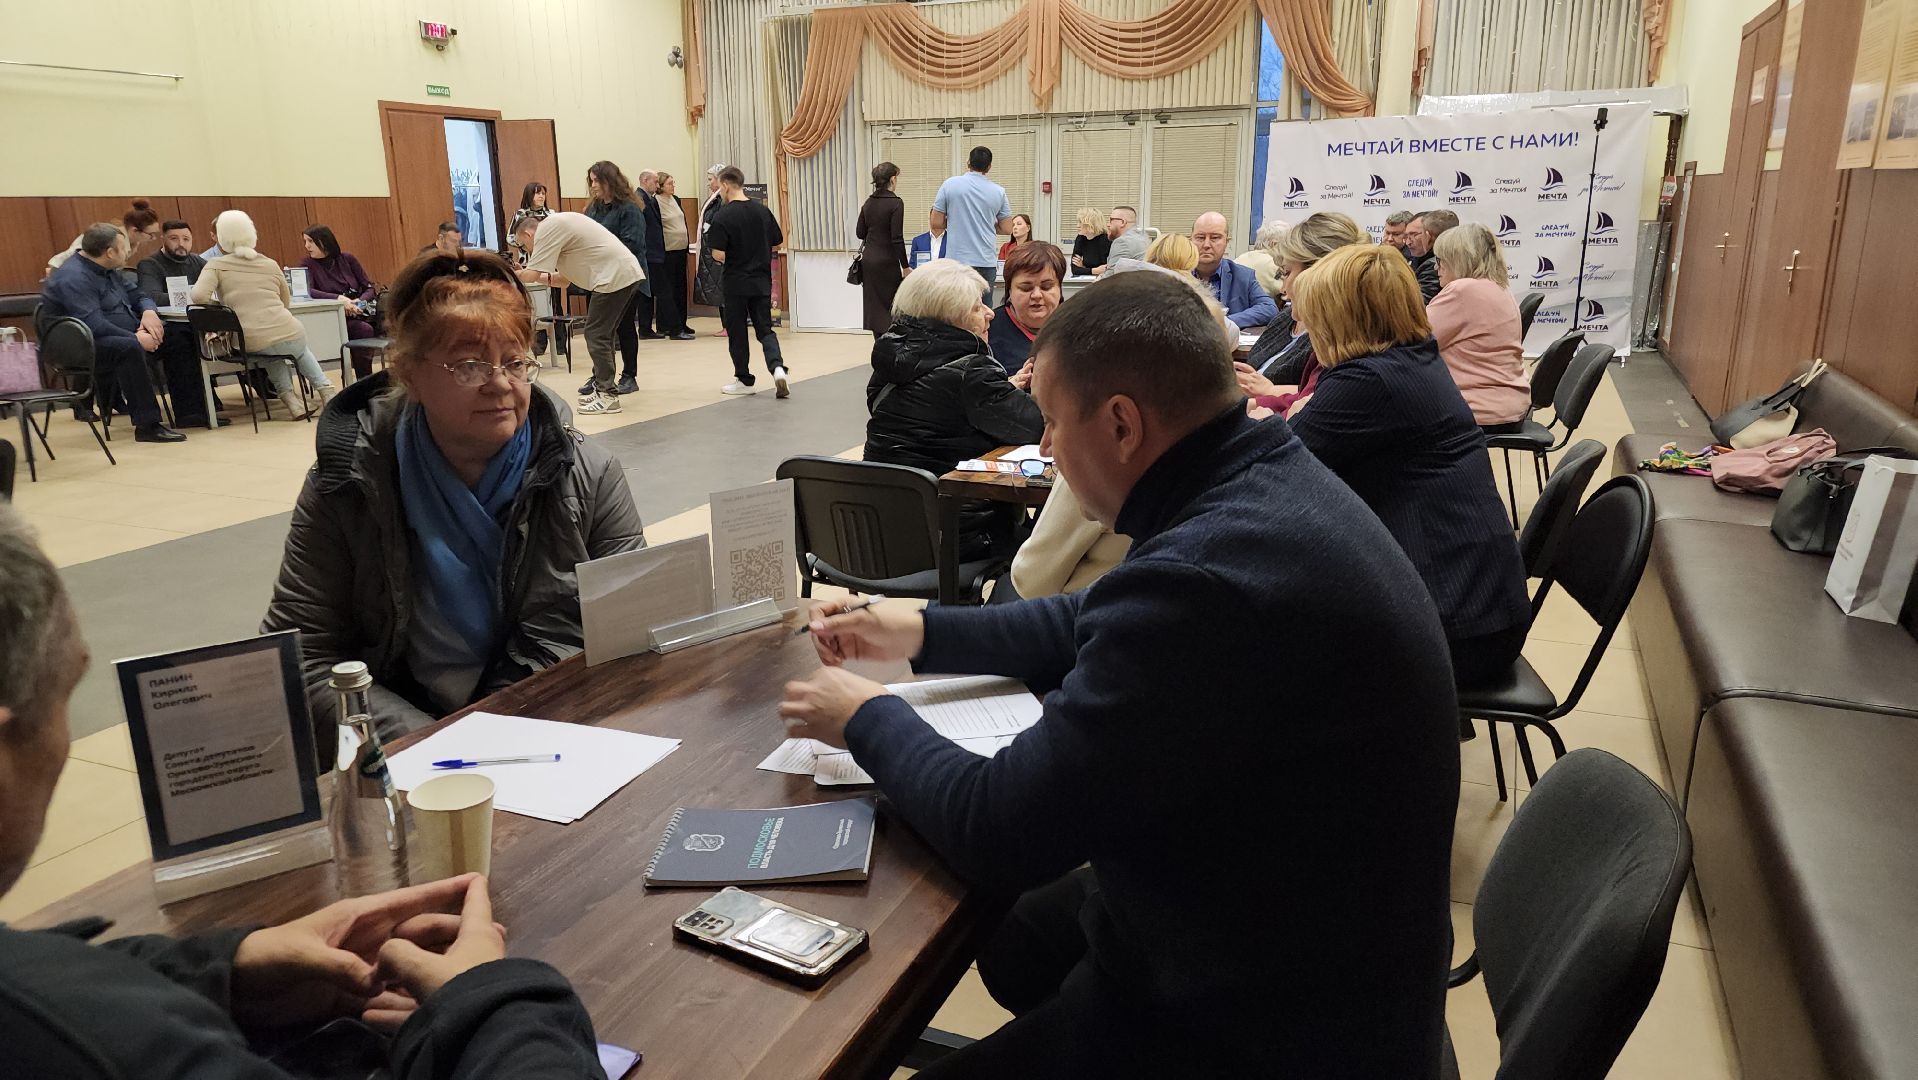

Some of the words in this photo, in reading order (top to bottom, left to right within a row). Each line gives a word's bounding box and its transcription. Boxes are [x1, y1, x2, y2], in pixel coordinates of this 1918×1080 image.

[1327, 138, 1403, 156] МЕЧТАЙ
[1409, 136, 1487, 153] ВМЕСТЕ
[1492, 135, 1505, 150] С
[1510, 132, 1579, 149] НАМИ!
[1407, 177, 1433, 187] СЛЕДУЙ
[1588, 237, 1619, 245] МЕЧТА
[1529, 280, 1559, 288] МЕЧТА
[149, 672, 193, 689] ПАНИН
[151, 684, 198, 699] Кирилл
[153, 693, 213, 710] Олегович
